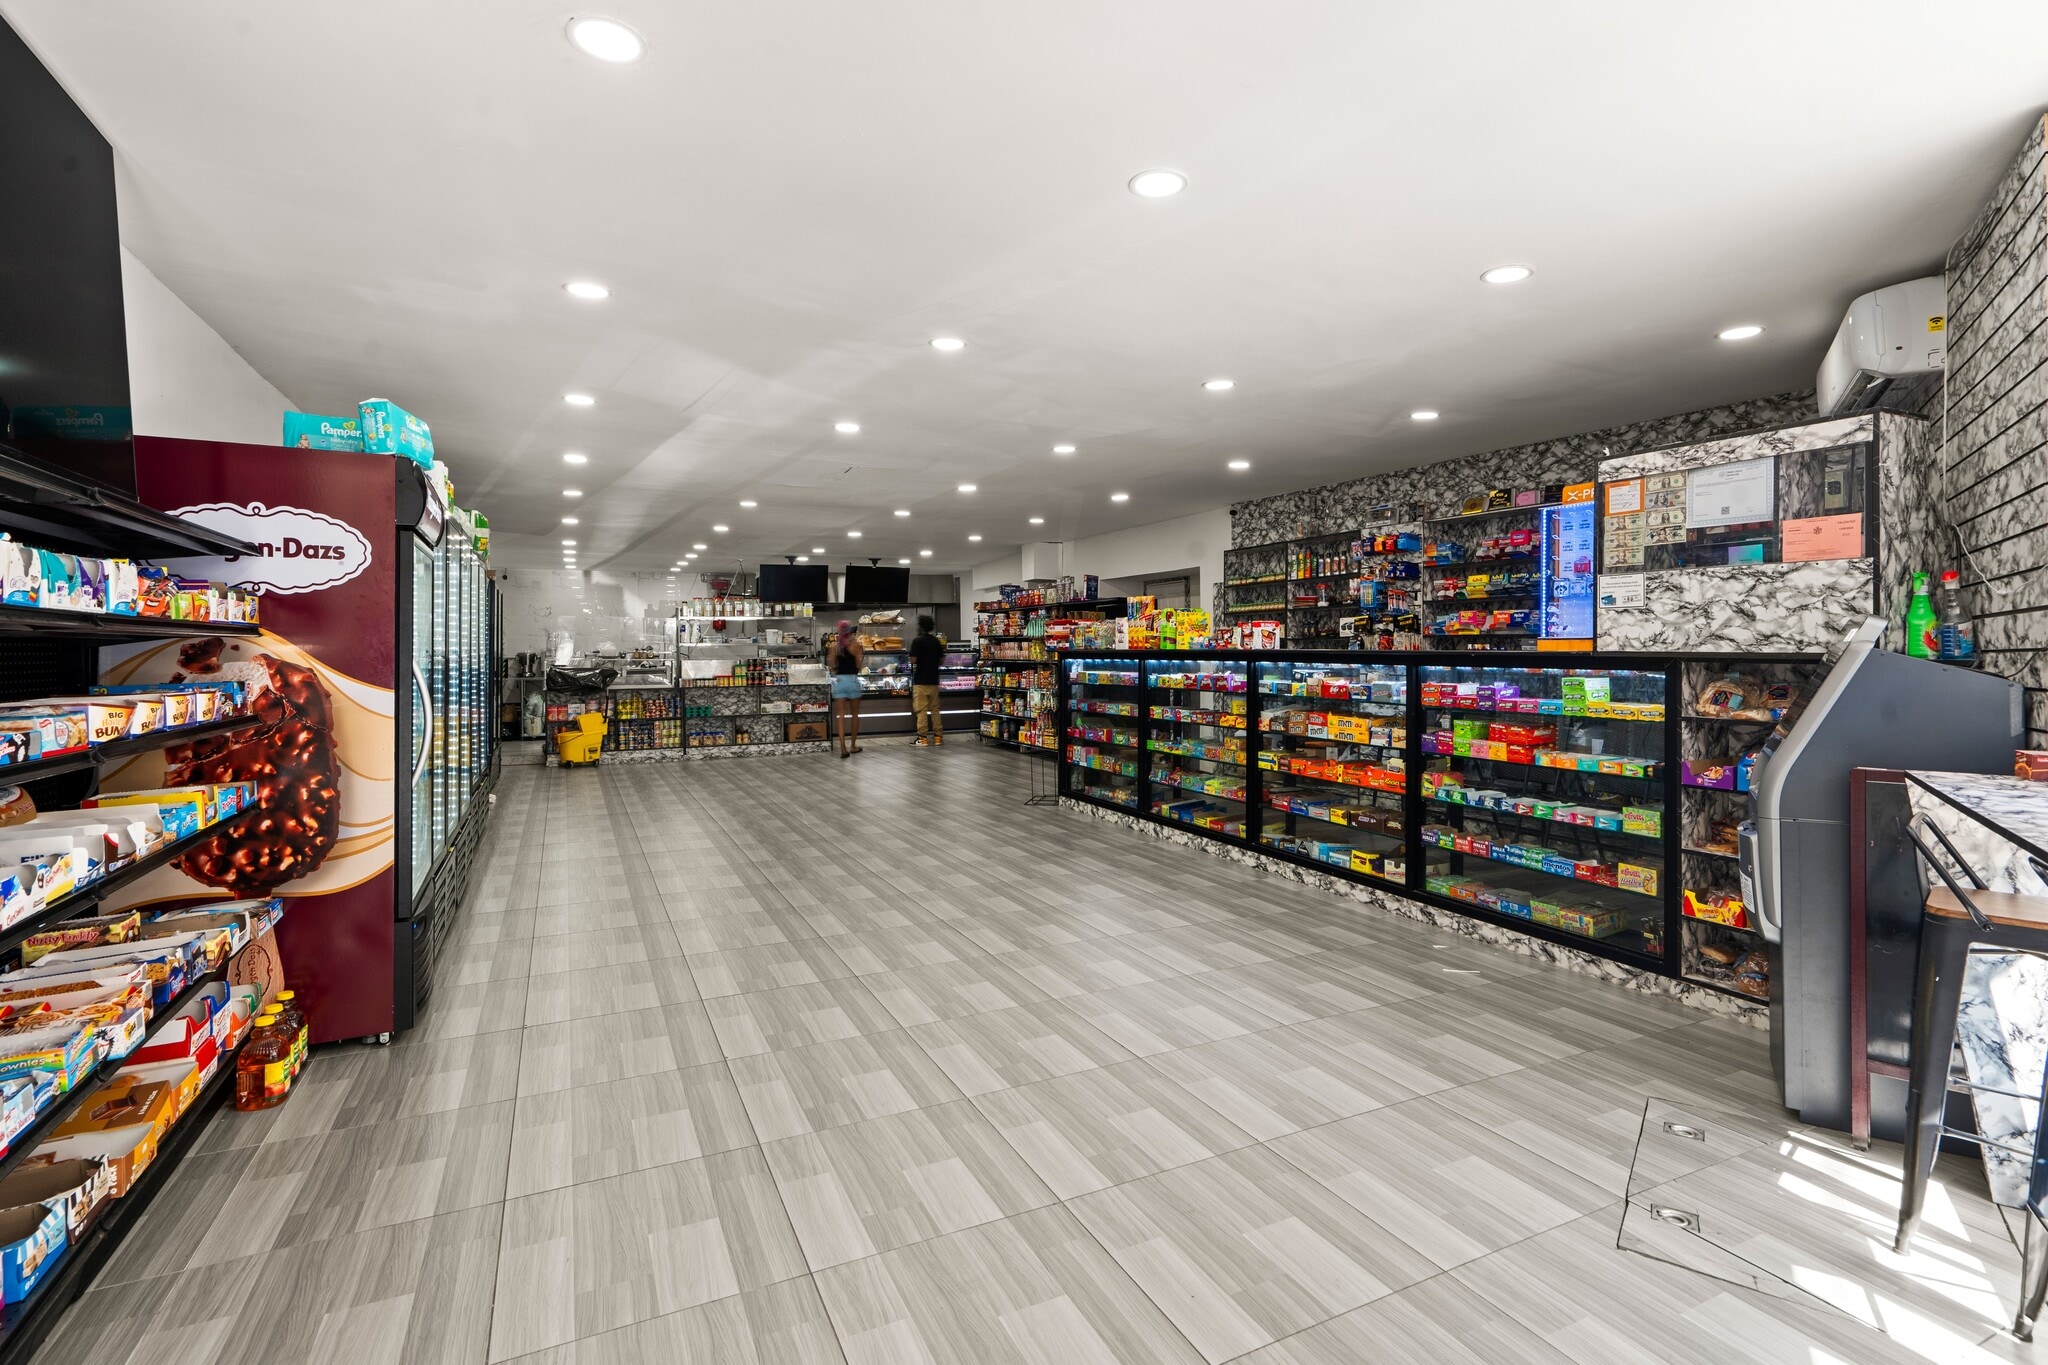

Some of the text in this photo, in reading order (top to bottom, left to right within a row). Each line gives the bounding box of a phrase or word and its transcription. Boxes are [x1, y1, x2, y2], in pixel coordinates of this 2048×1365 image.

[320, 422, 362, 438] Pamper
[375, 411, 387, 439] Pampers
[108, 711, 124, 719] BIG
[1543, 861, 1571, 872] mentos
[26, 930, 100, 948] Nutty Buddy
[0, 1057, 46, 1073] ownies
